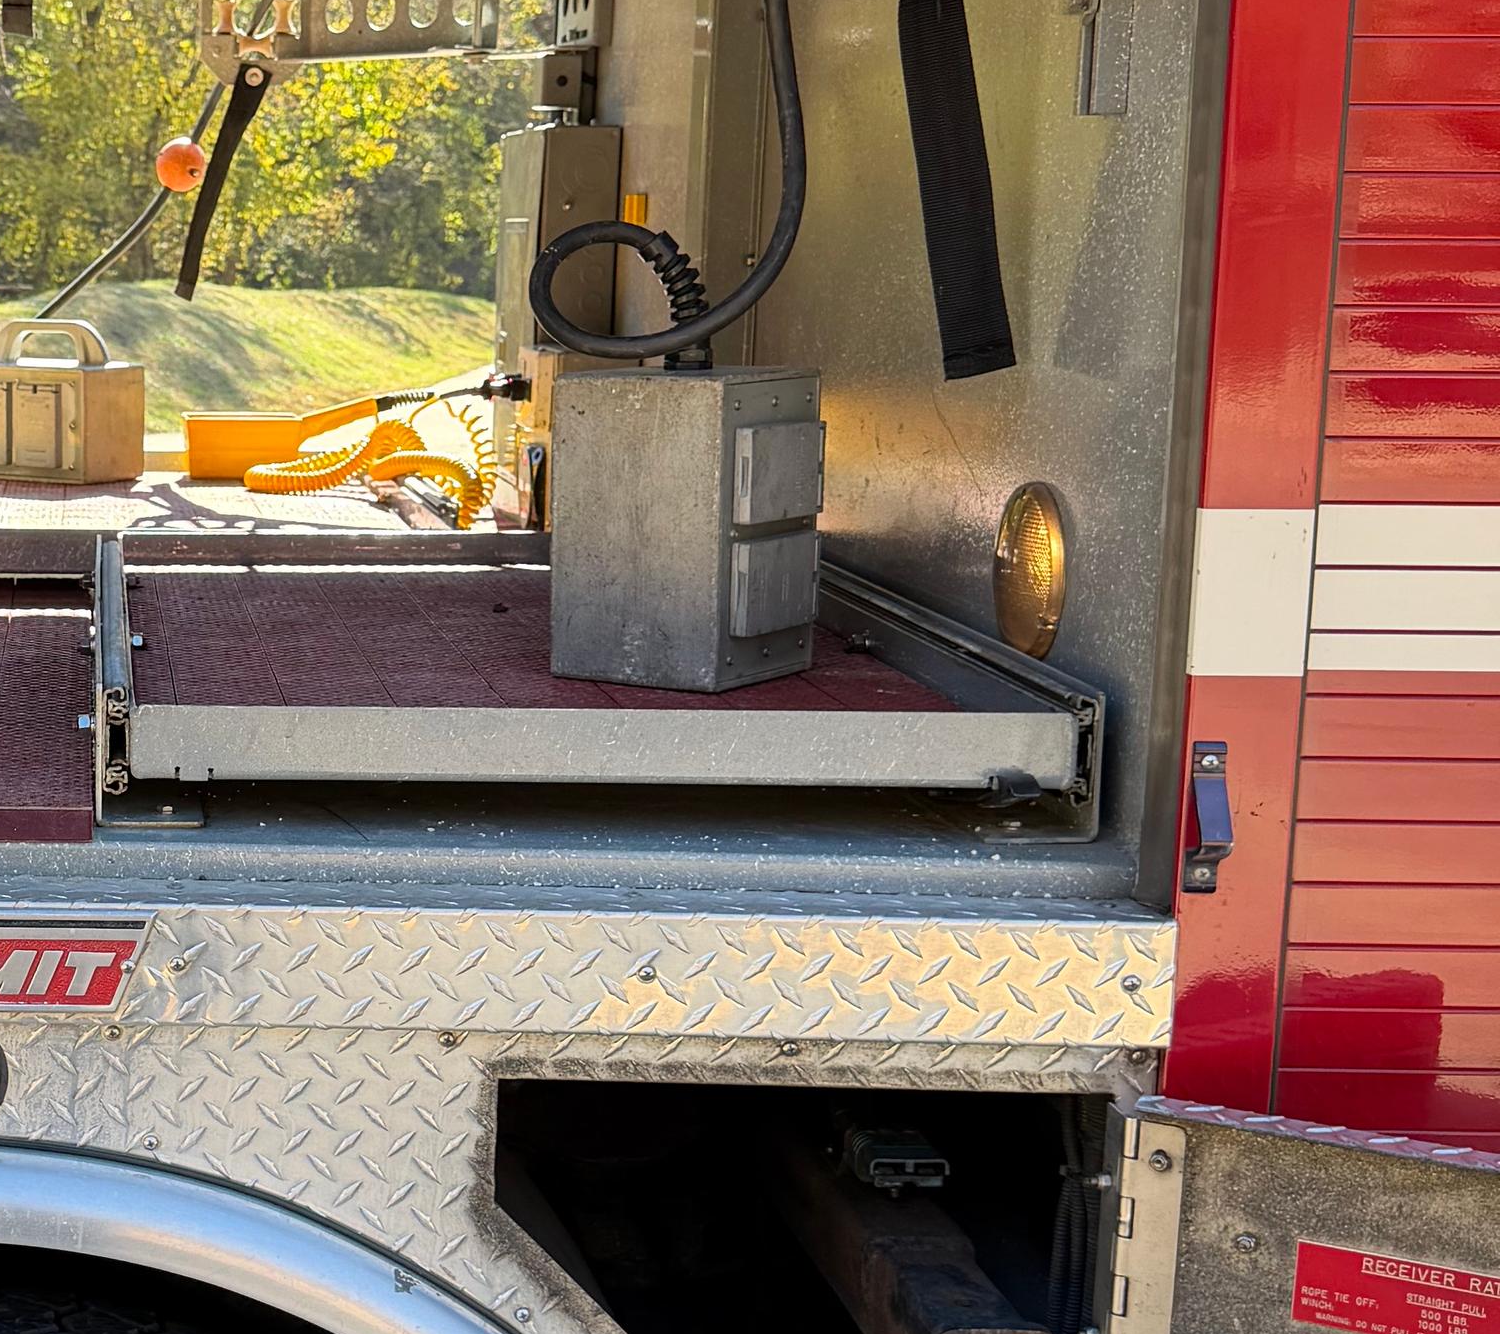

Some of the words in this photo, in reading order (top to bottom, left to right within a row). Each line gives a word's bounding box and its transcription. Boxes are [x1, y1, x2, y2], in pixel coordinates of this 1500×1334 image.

[1362, 1256, 1456, 1288] RECEIVER
[1300, 1285, 1329, 1299] ROPE
[1333, 1291, 1350, 1304] TIE
[1420, 1309, 1442, 1321] 500
[1406, 1292, 1456, 1310] STRAIGHT
[1461, 1303, 1486, 1317] PULL
[1355, 1319, 1368, 1329] DO
[1370, 1323, 1387, 1333] NOT
[1418, 1319, 1443, 1333] 1000
